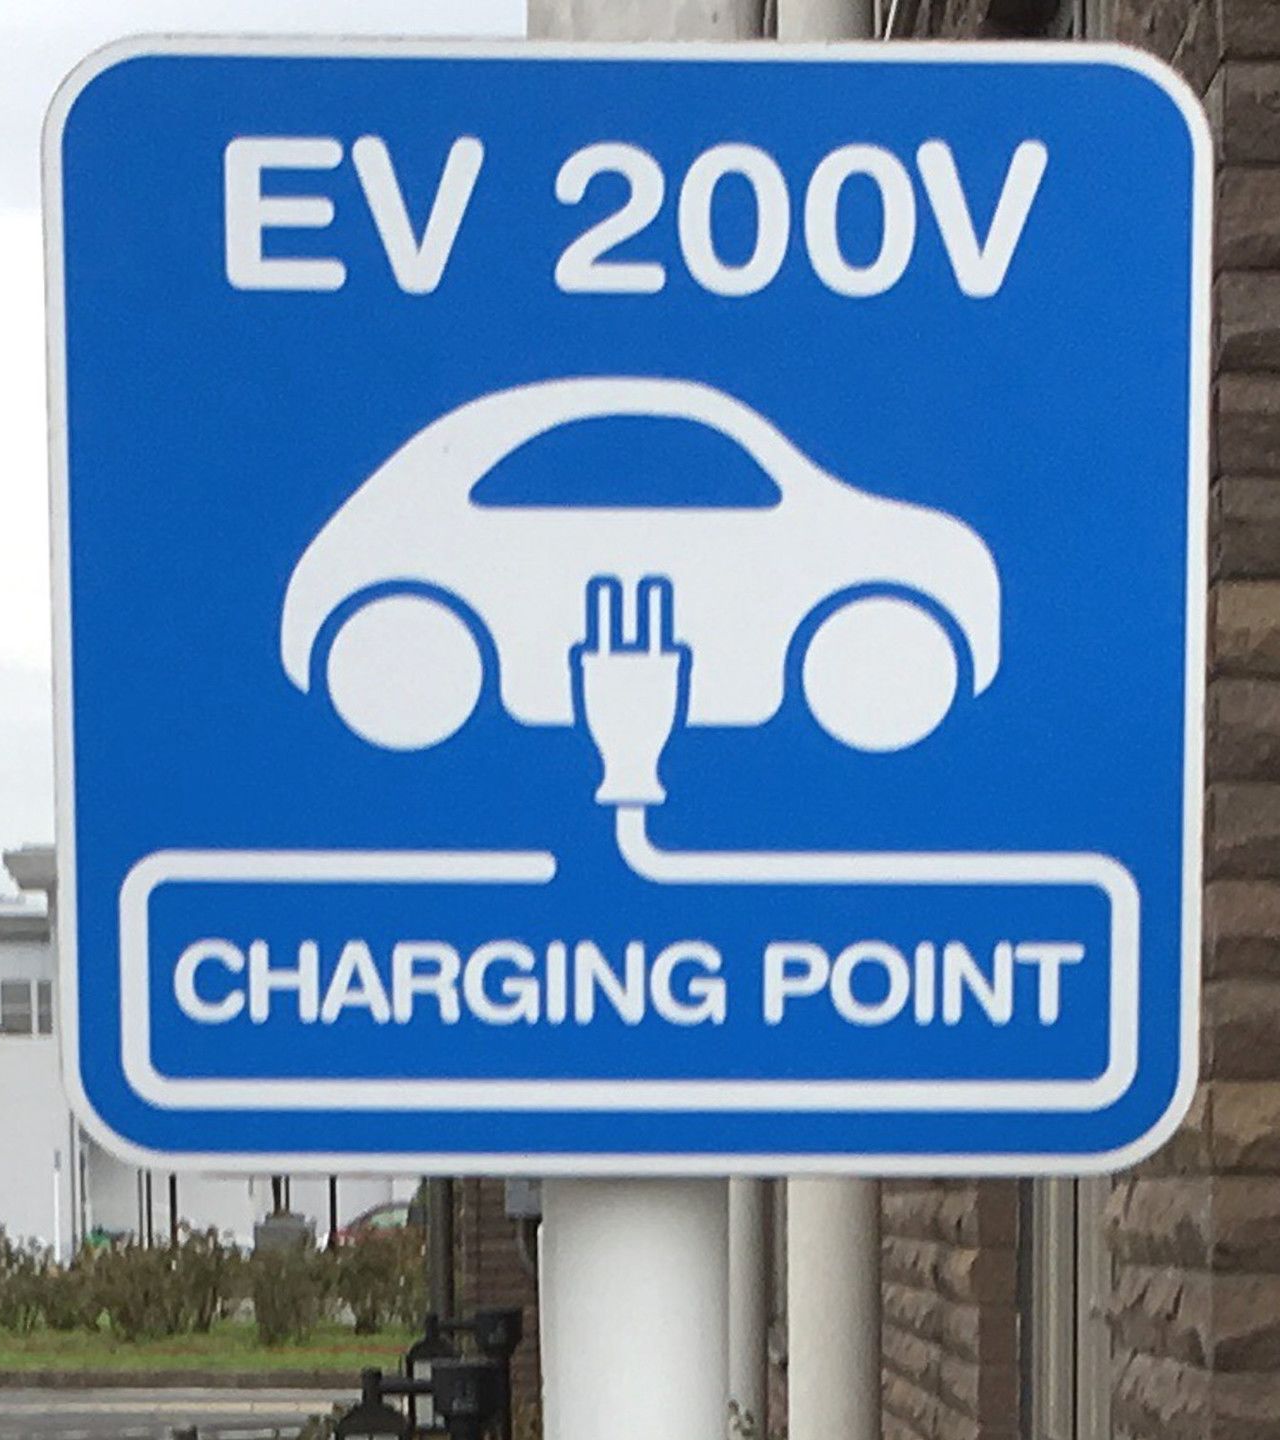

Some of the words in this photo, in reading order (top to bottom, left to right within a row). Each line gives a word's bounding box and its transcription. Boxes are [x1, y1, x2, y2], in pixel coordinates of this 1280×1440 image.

[224, 136, 485, 295] EV
[553, 140, 1049, 299] 200V
[173, 940, 724, 1026] CHARGING
[763, 942, 1086, 1026] POINT
